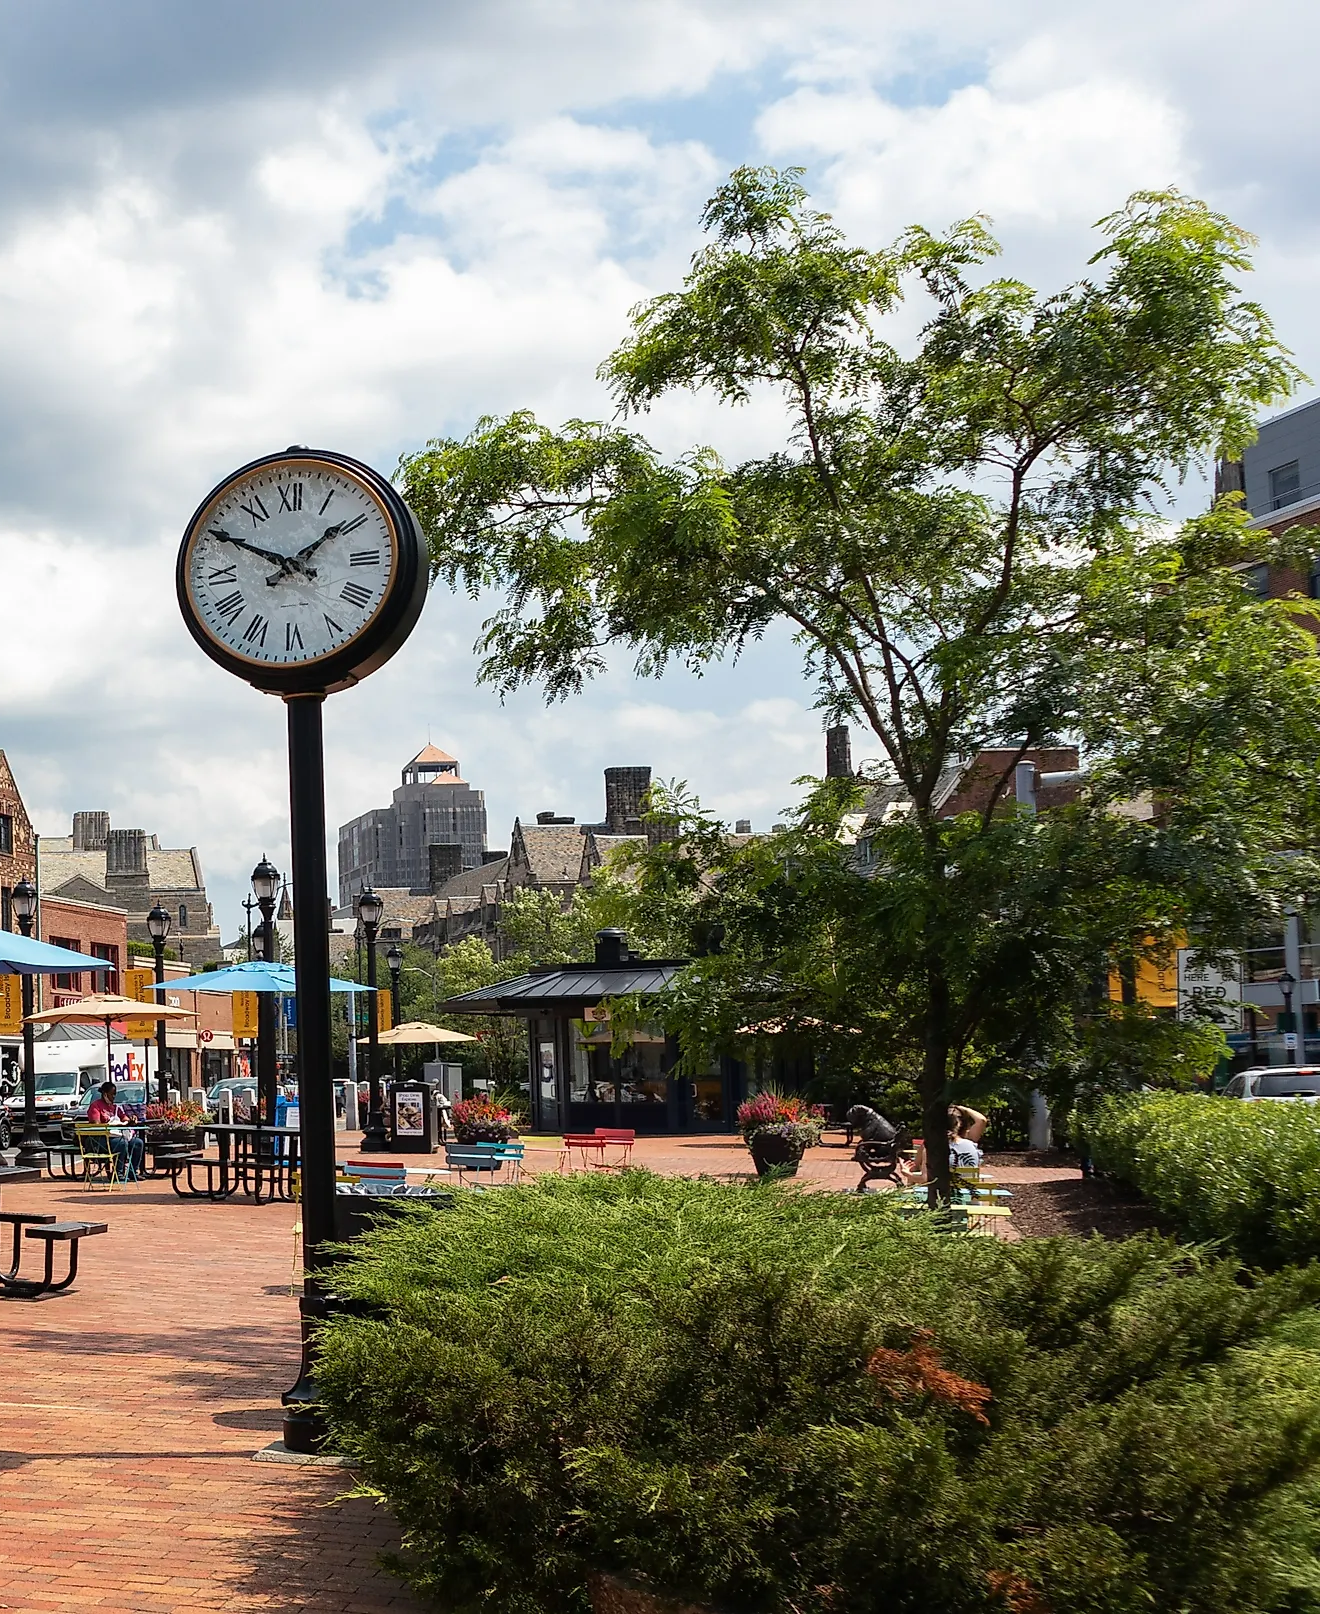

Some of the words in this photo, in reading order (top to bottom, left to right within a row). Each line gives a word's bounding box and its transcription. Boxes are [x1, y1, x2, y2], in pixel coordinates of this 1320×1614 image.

[240, 494, 270, 528] XI
[277, 482, 303, 514] XII
[1184, 973, 1210, 981] HERE
[1192, 986, 1227, 999] RED
[109, 1052, 144, 1081] FedEx
